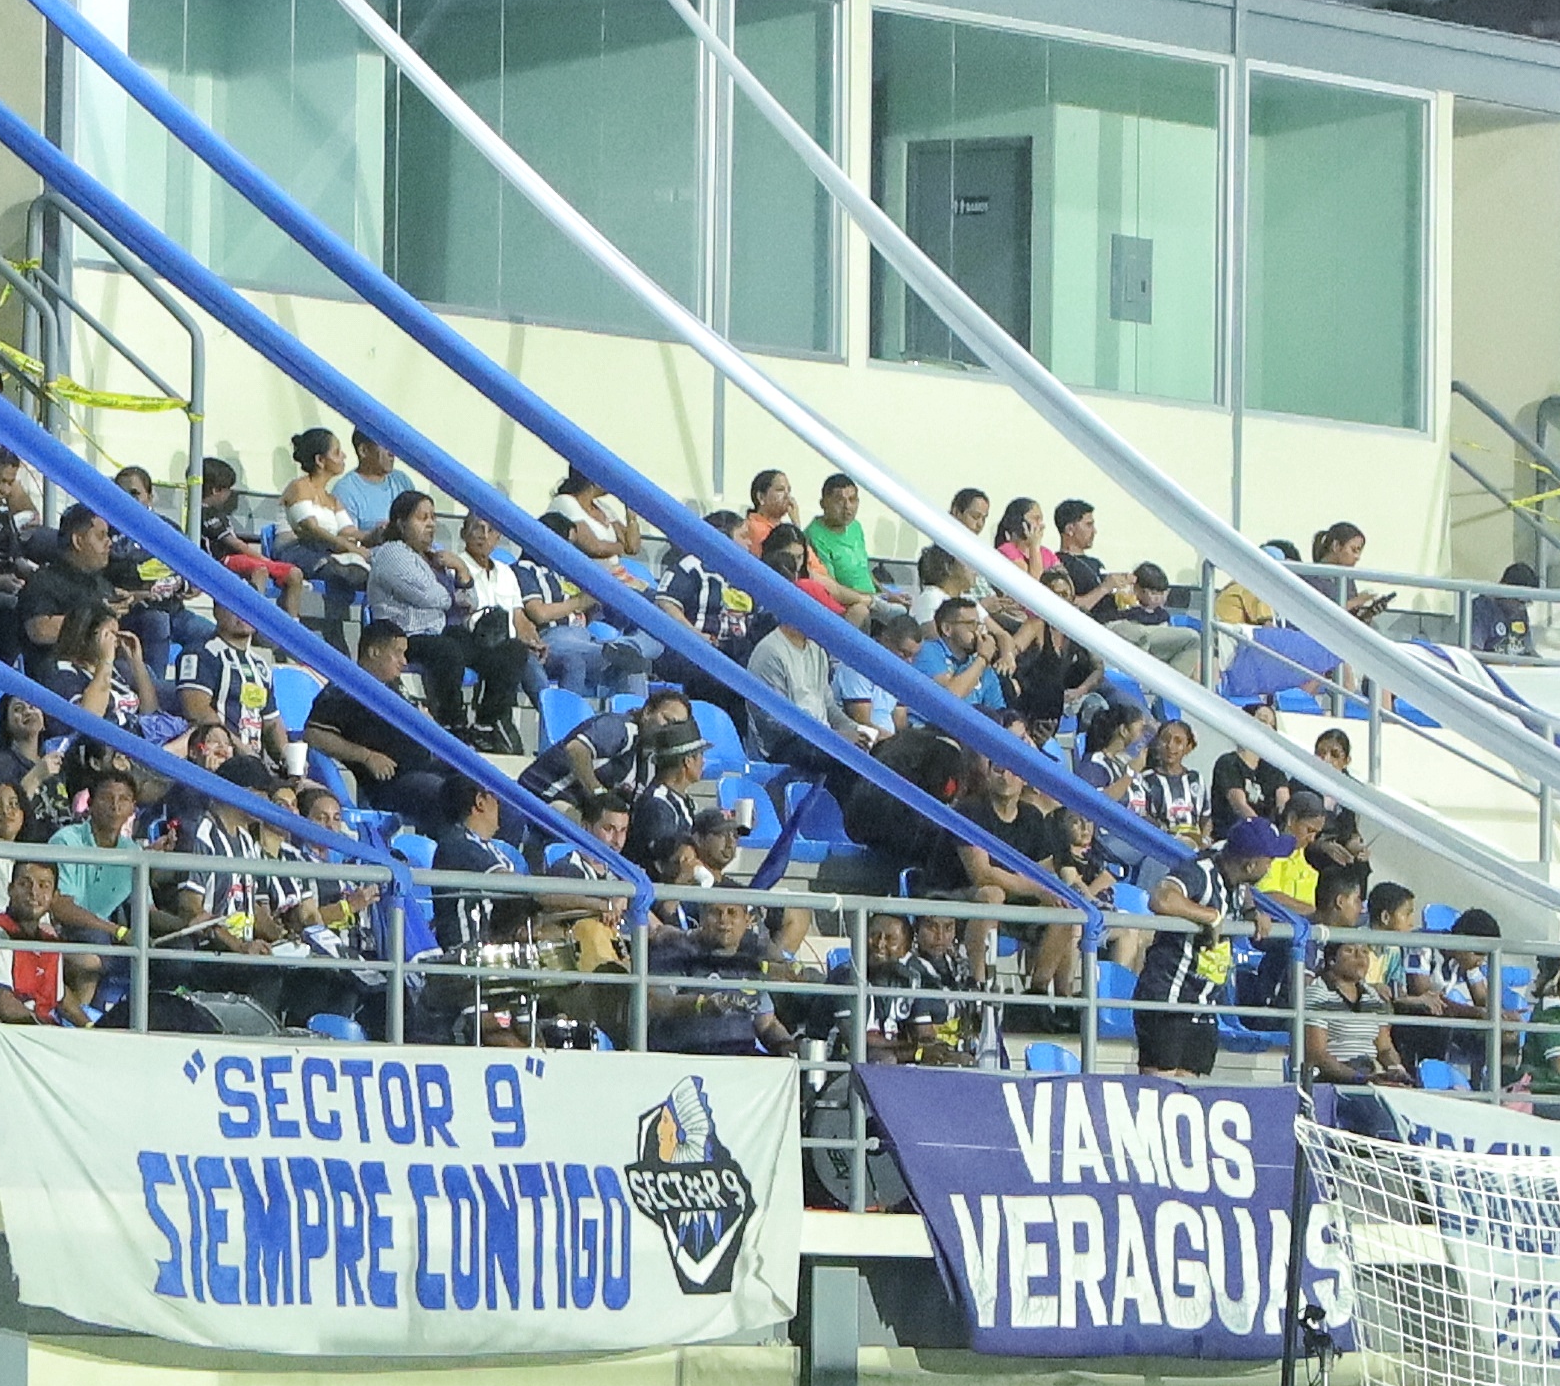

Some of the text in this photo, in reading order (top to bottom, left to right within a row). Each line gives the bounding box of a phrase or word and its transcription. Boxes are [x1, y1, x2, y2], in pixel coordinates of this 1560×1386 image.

[721, 1168, 746, 1213] 9
[1002, 1081, 1257, 1199] VAMOS
[136, 1150, 632, 1311] SIEMPRE CONTIGO
[949, 1193, 1354, 1336] VERAGUAS
